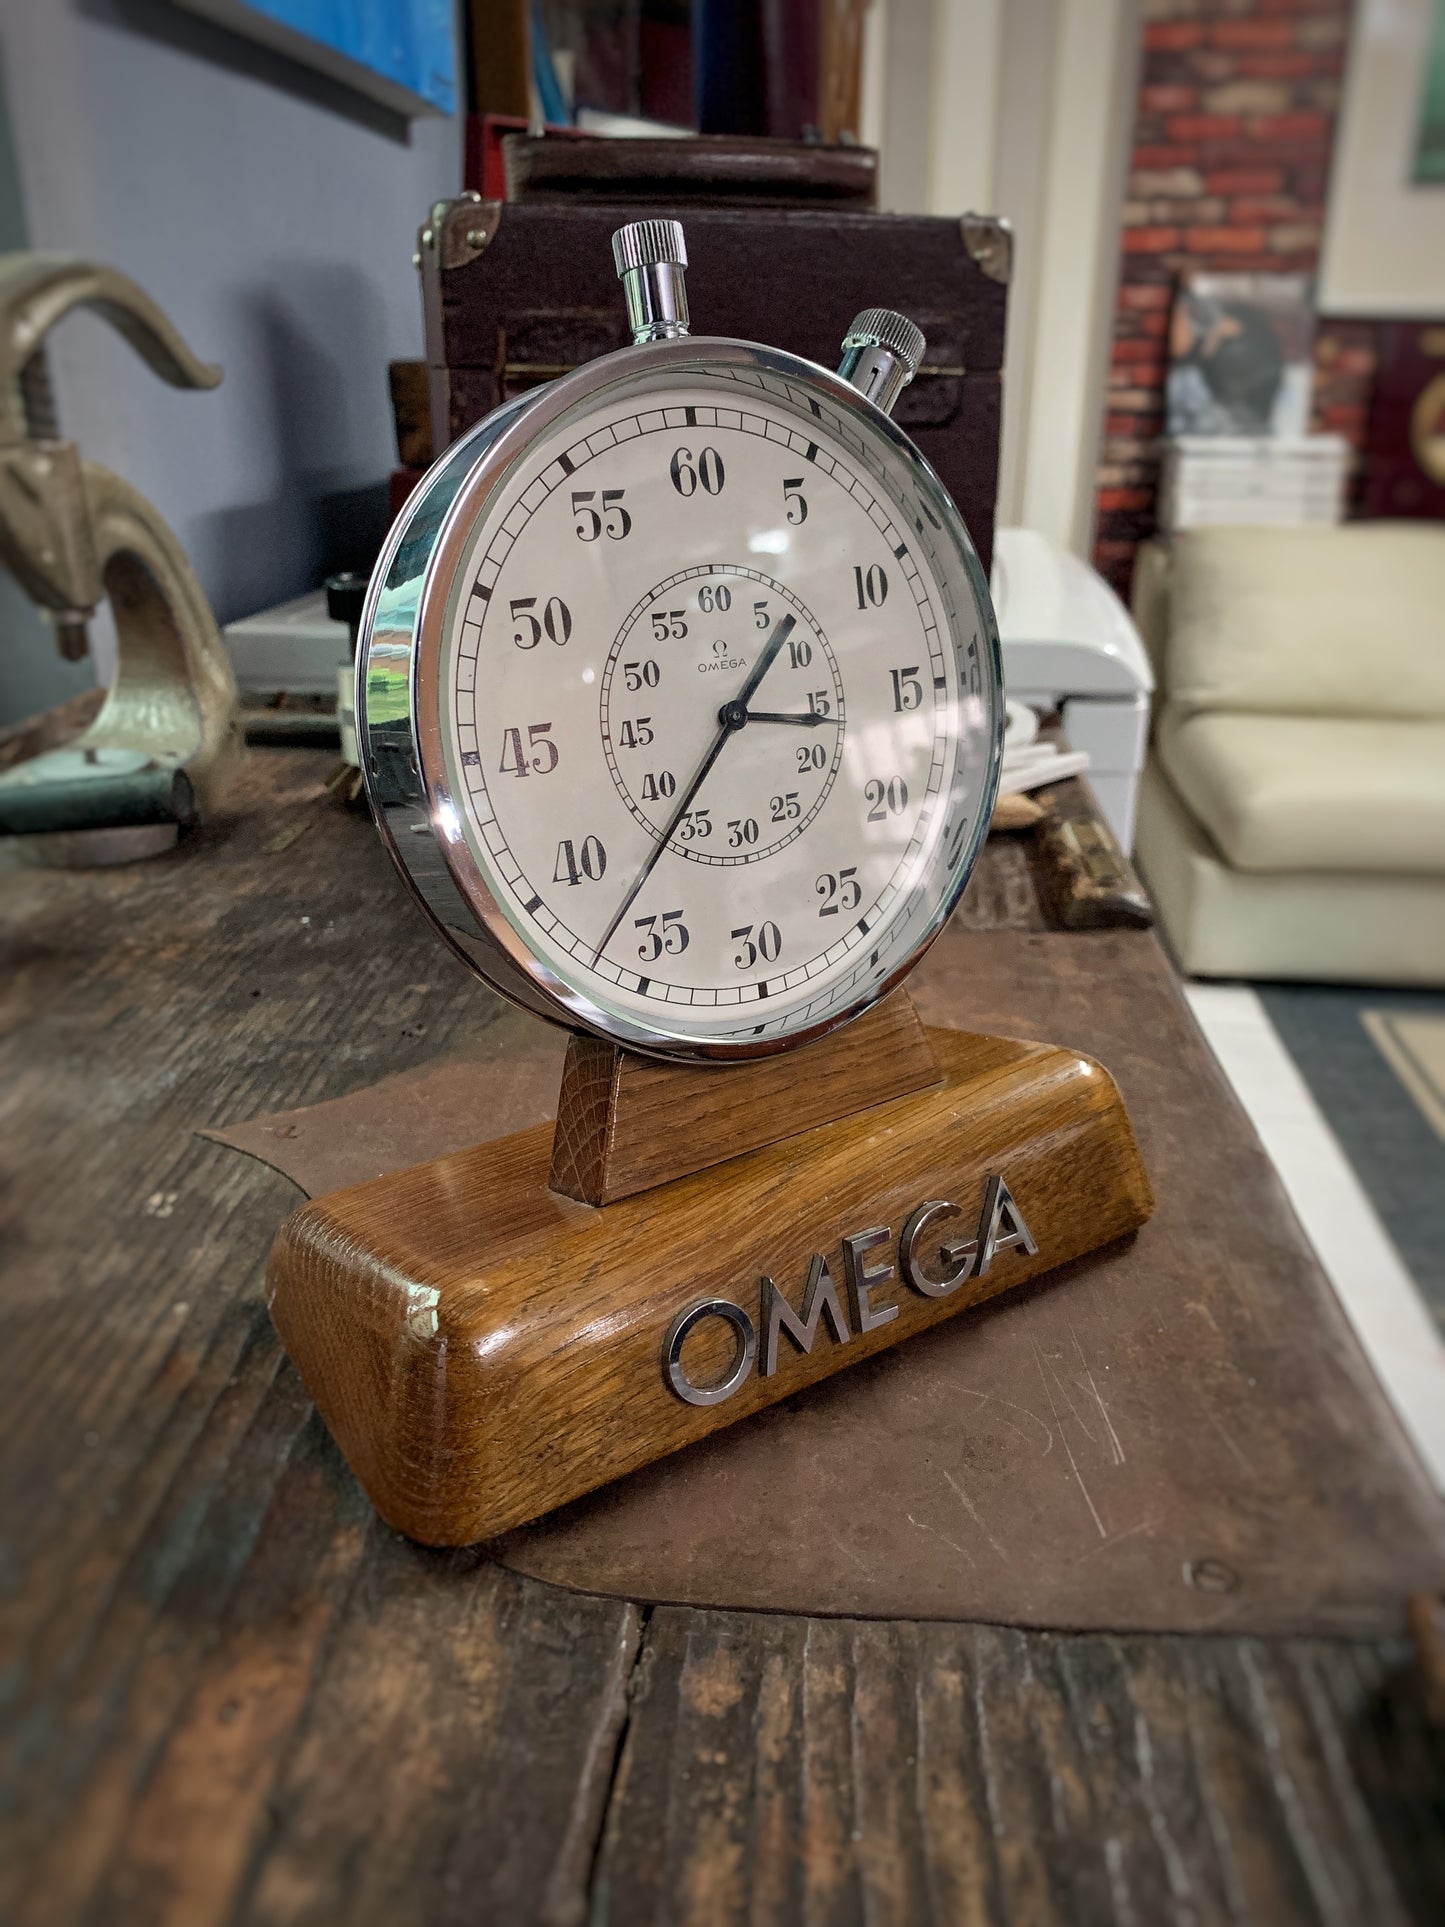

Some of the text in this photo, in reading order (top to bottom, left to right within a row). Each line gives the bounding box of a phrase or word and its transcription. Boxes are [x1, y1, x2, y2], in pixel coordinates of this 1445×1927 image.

[670, 446, 726, 497] 60
[570, 488, 632, 542] 55
[782, 477, 808, 526] 5
[698, 585, 732, 613] 60
[853, 563, 888, 610] 10
[510, 596, 572, 650] 50
[651, 610, 688, 641] 55
[753, 601, 770, 629] 5
[698, 658, 747, 673] OMEGA
[787, 641, 812, 669] 10
[624, 660, 660, 691] 50
[889, 666, 924, 713] 15
[806, 691, 830, 716] 15
[498, 722, 560, 778] 45
[619, 717, 654, 749] 45
[795, 744, 826, 774] 20
[641, 771, 676, 801] 40
[864, 775, 909, 823] 20
[678, 809, 713, 840] 35
[769, 792, 801, 822] 25
[727, 818, 759, 847] 30
[552, 834, 608, 887] 40
[815, 866, 862, 918] 25
[634, 909, 691, 962] 35
[730, 920, 782, 970] 30
[662, 1175, 1039, 1406] OMEGA
